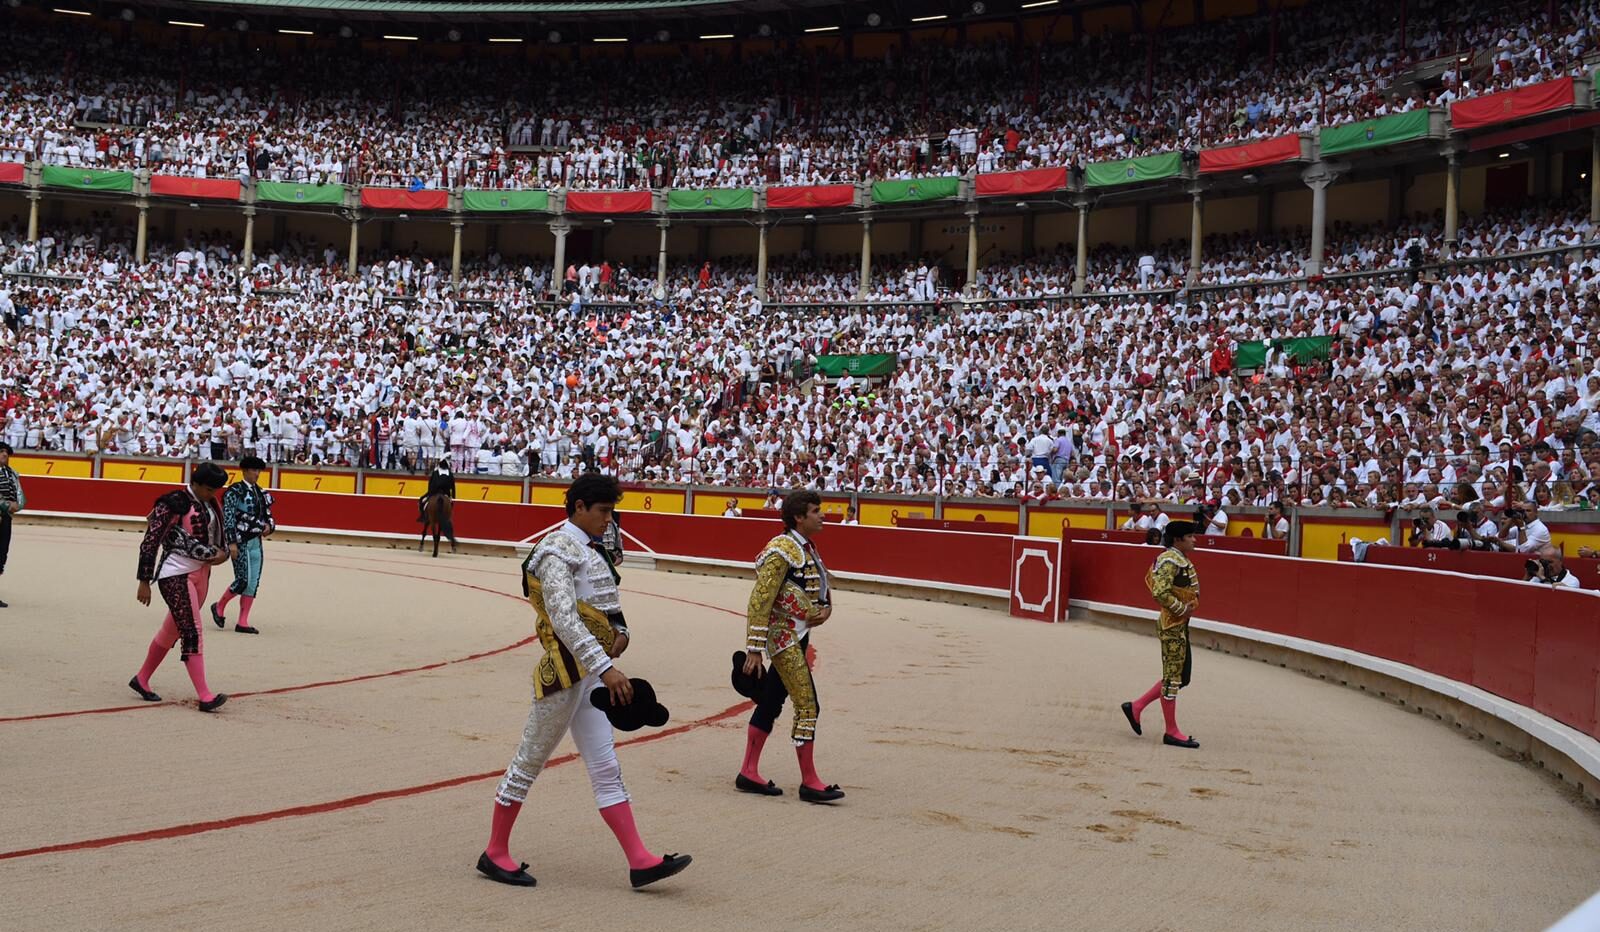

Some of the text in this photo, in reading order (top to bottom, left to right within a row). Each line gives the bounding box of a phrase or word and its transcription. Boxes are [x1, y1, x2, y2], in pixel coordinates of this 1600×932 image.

[46, 462, 54, 474] 7
[139, 468, 147, 480] 7
[229, 472, 236, 484] 7
[314, 477, 322, 490] 7
[398, 482, 406, 494] 7
[481, 486, 488, 500] 7
[644, 496, 652, 510] 8
[891, 509, 898, 525] 8
